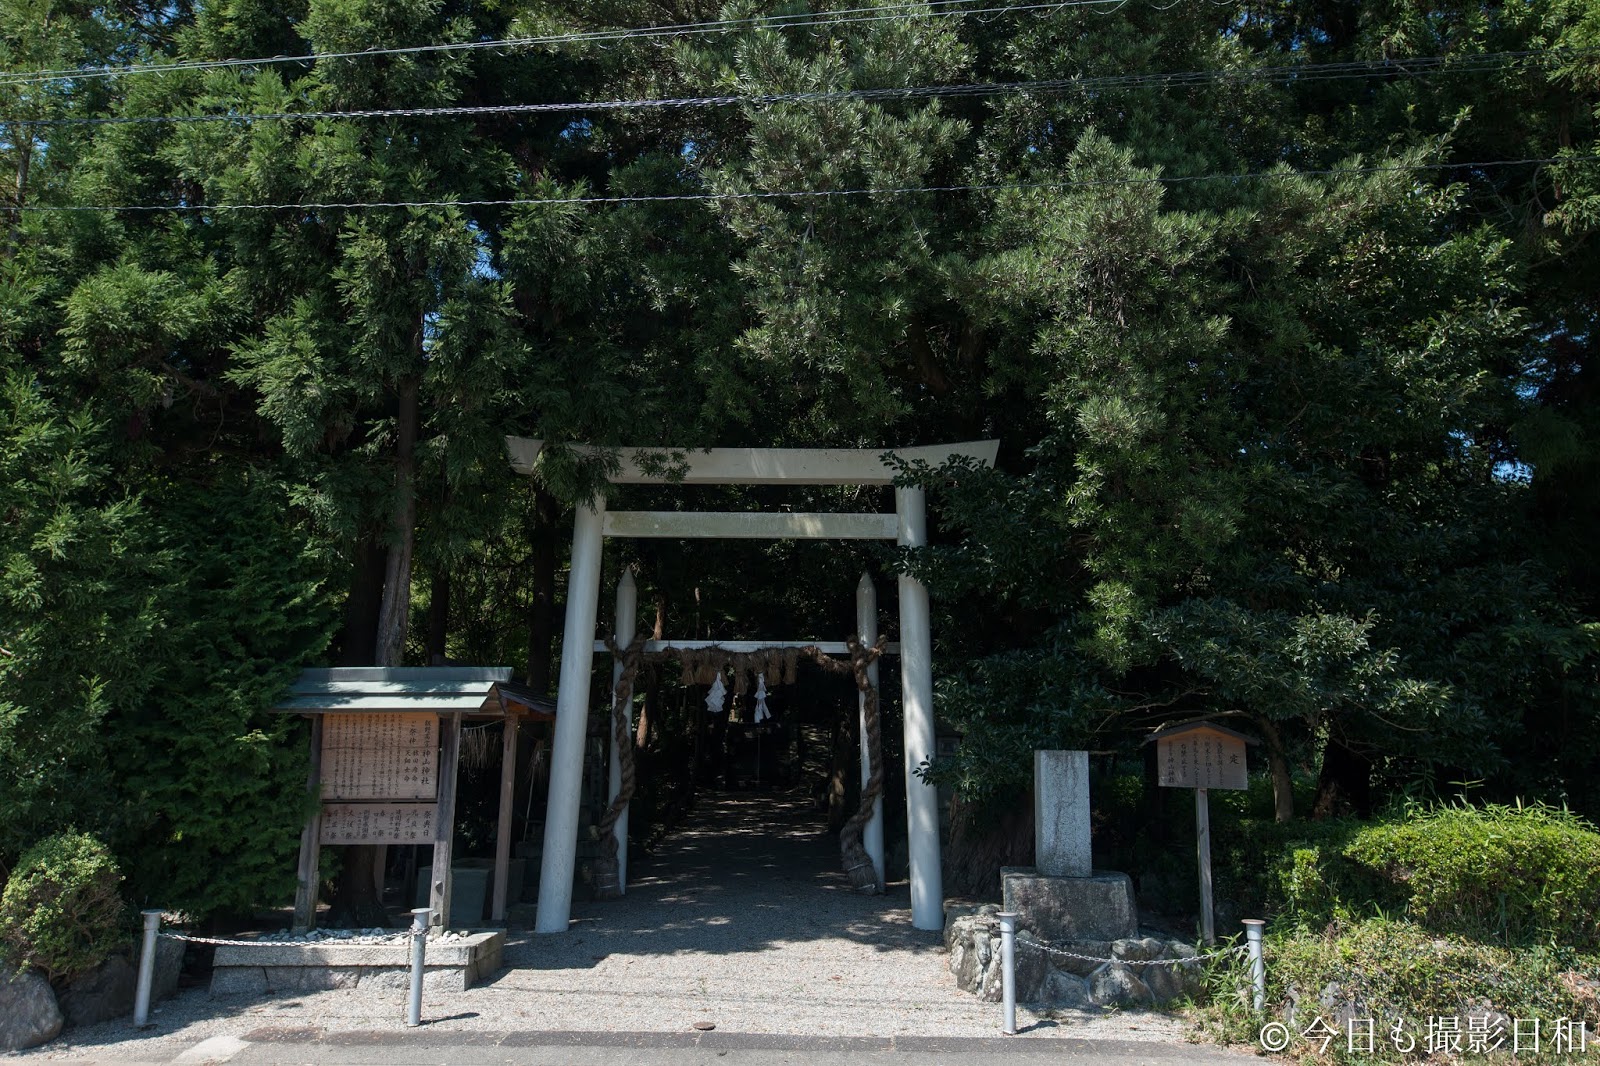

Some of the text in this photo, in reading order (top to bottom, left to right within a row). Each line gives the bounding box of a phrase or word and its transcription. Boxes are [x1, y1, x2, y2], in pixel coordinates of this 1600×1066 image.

[1229, 753, 1240, 765] 定
[423, 810, 432, 837] 祭典日
